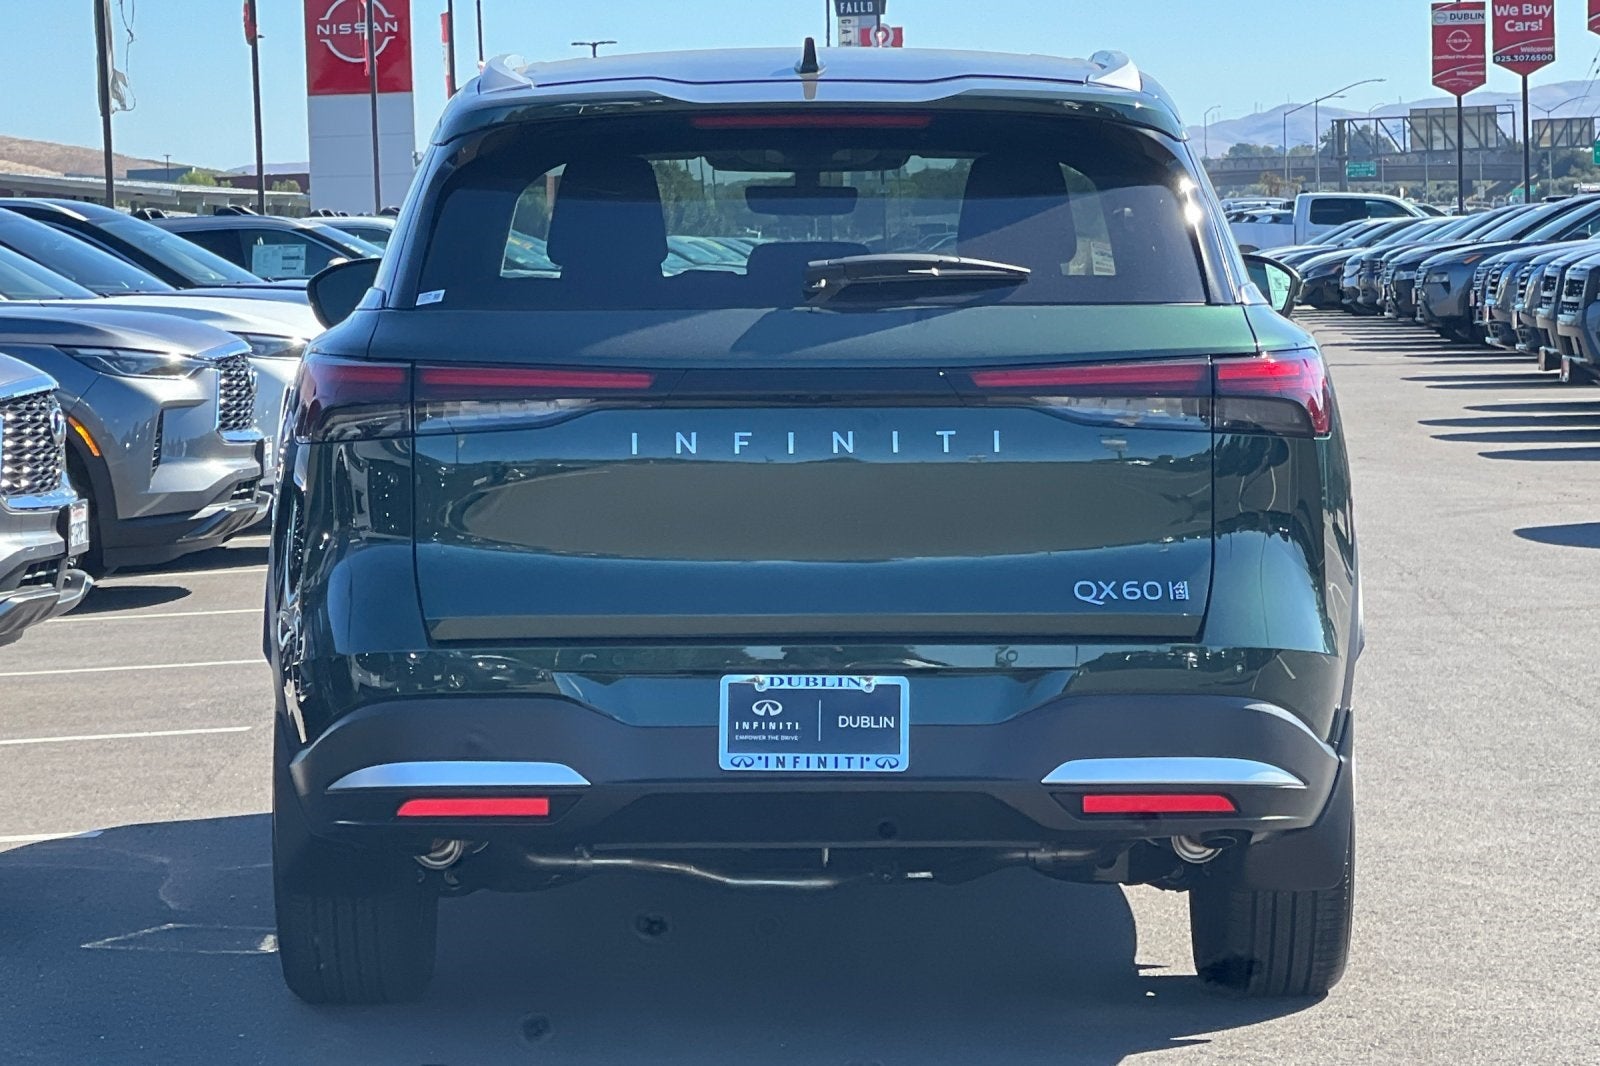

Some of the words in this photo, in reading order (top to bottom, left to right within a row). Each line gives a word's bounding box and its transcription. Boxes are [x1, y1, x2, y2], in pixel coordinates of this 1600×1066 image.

[840, 2, 876, 13] FALLO
[1494, 4, 1519, 17] We
[1522, 3, 1553, 19] Buy
[316, 22, 398, 35] NISSAN
[1504, 19, 1543, 32] Cars!
[1495, 54, 1553, 62] 925.307.6500
[630, 429, 1001, 456] INFINITI
[1073, 580, 1163, 606] QX60
[769, 677, 861, 687] DUBLIN
[735, 721, 800, 730] INFINITI
[838, 716, 895, 728] DUBLIN
[764, 756, 865, 769] INFINITI
